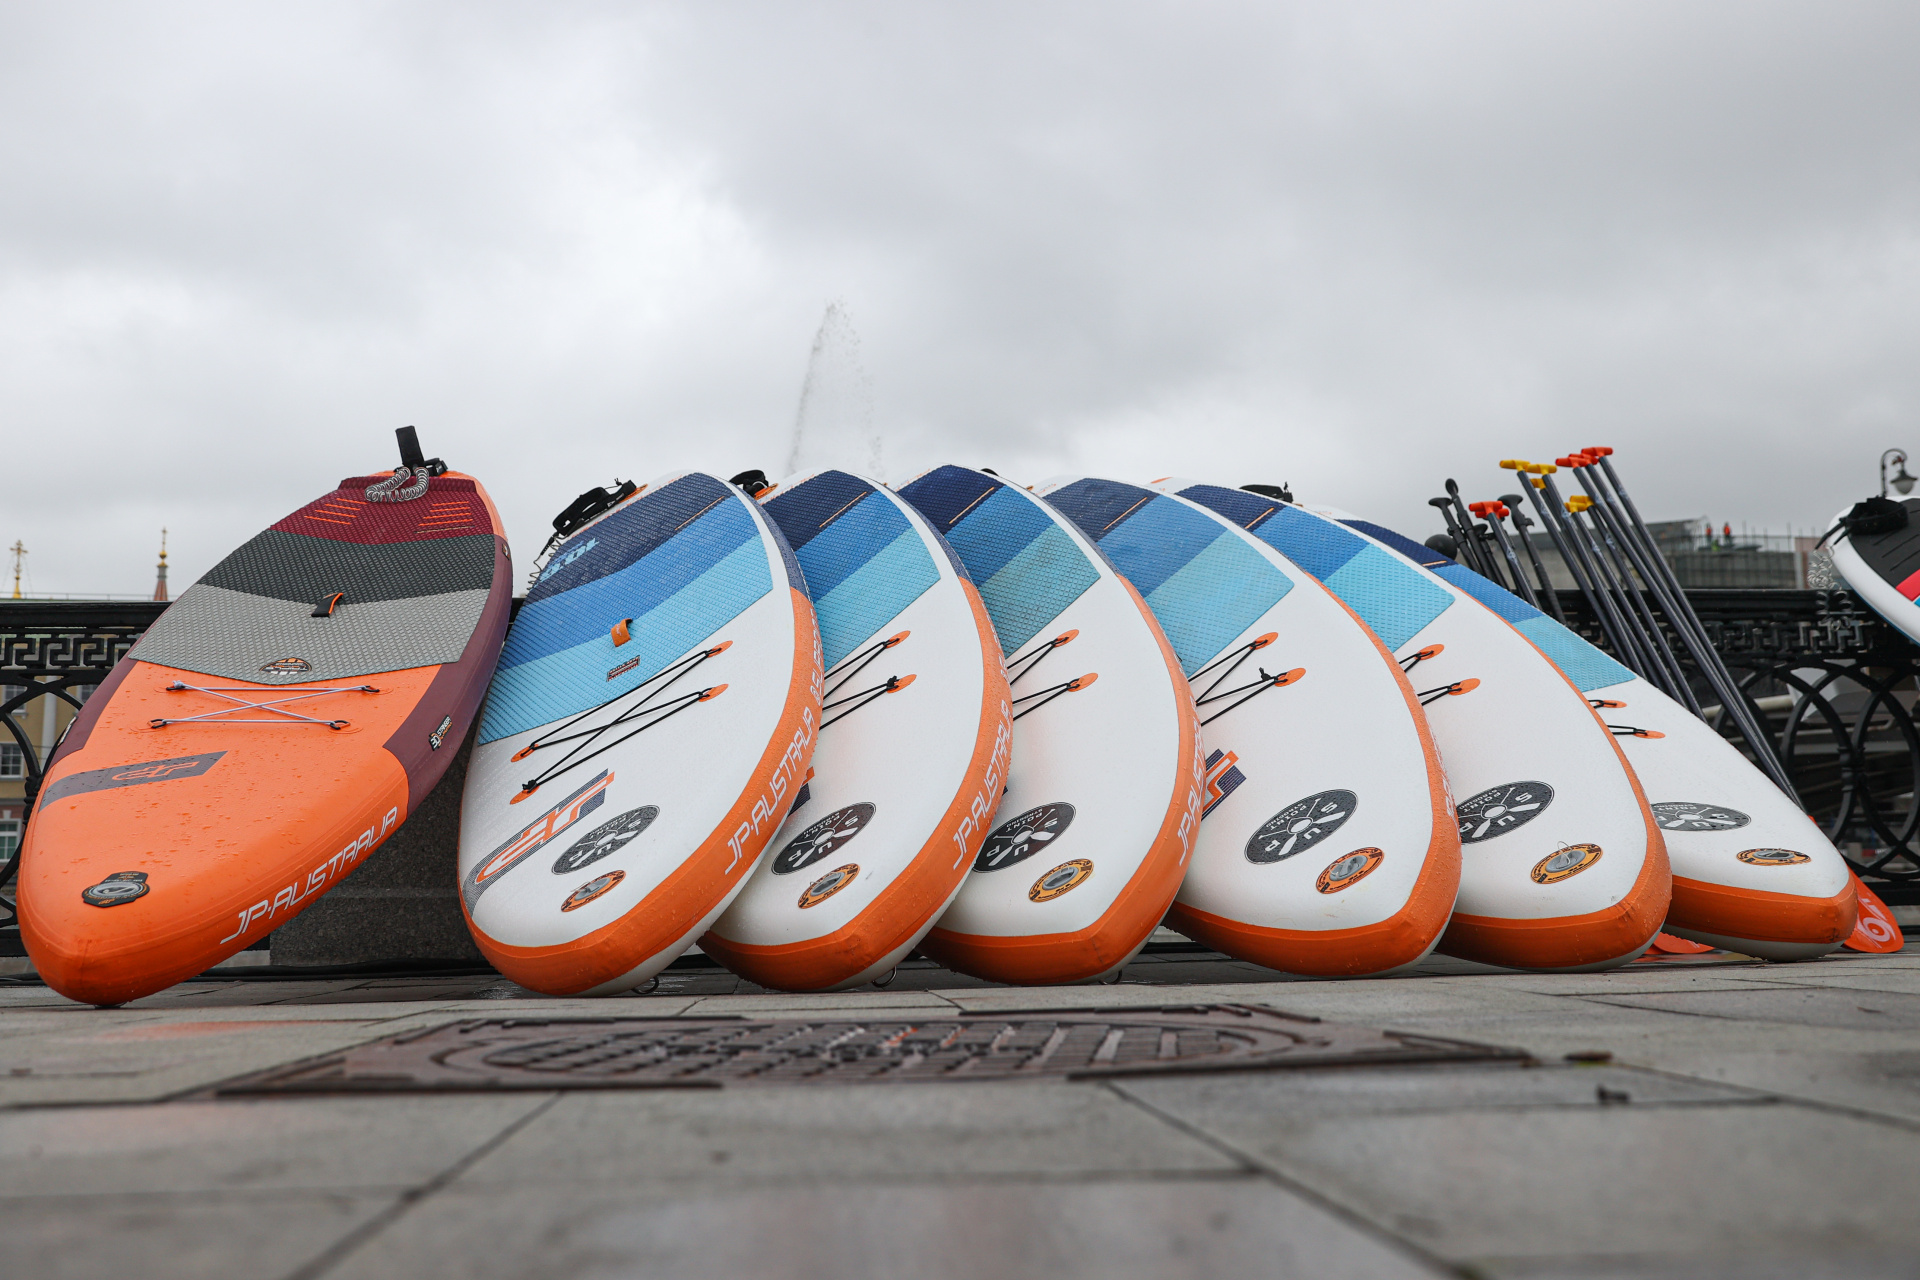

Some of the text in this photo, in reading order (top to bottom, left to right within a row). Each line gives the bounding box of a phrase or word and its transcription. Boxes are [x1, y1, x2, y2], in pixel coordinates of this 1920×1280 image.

[1464, 792, 1500, 812] POINT
[804, 815, 840, 838] POINT
[1006, 812, 1042, 832] POINT
[1271, 805, 1306, 830] POINT
